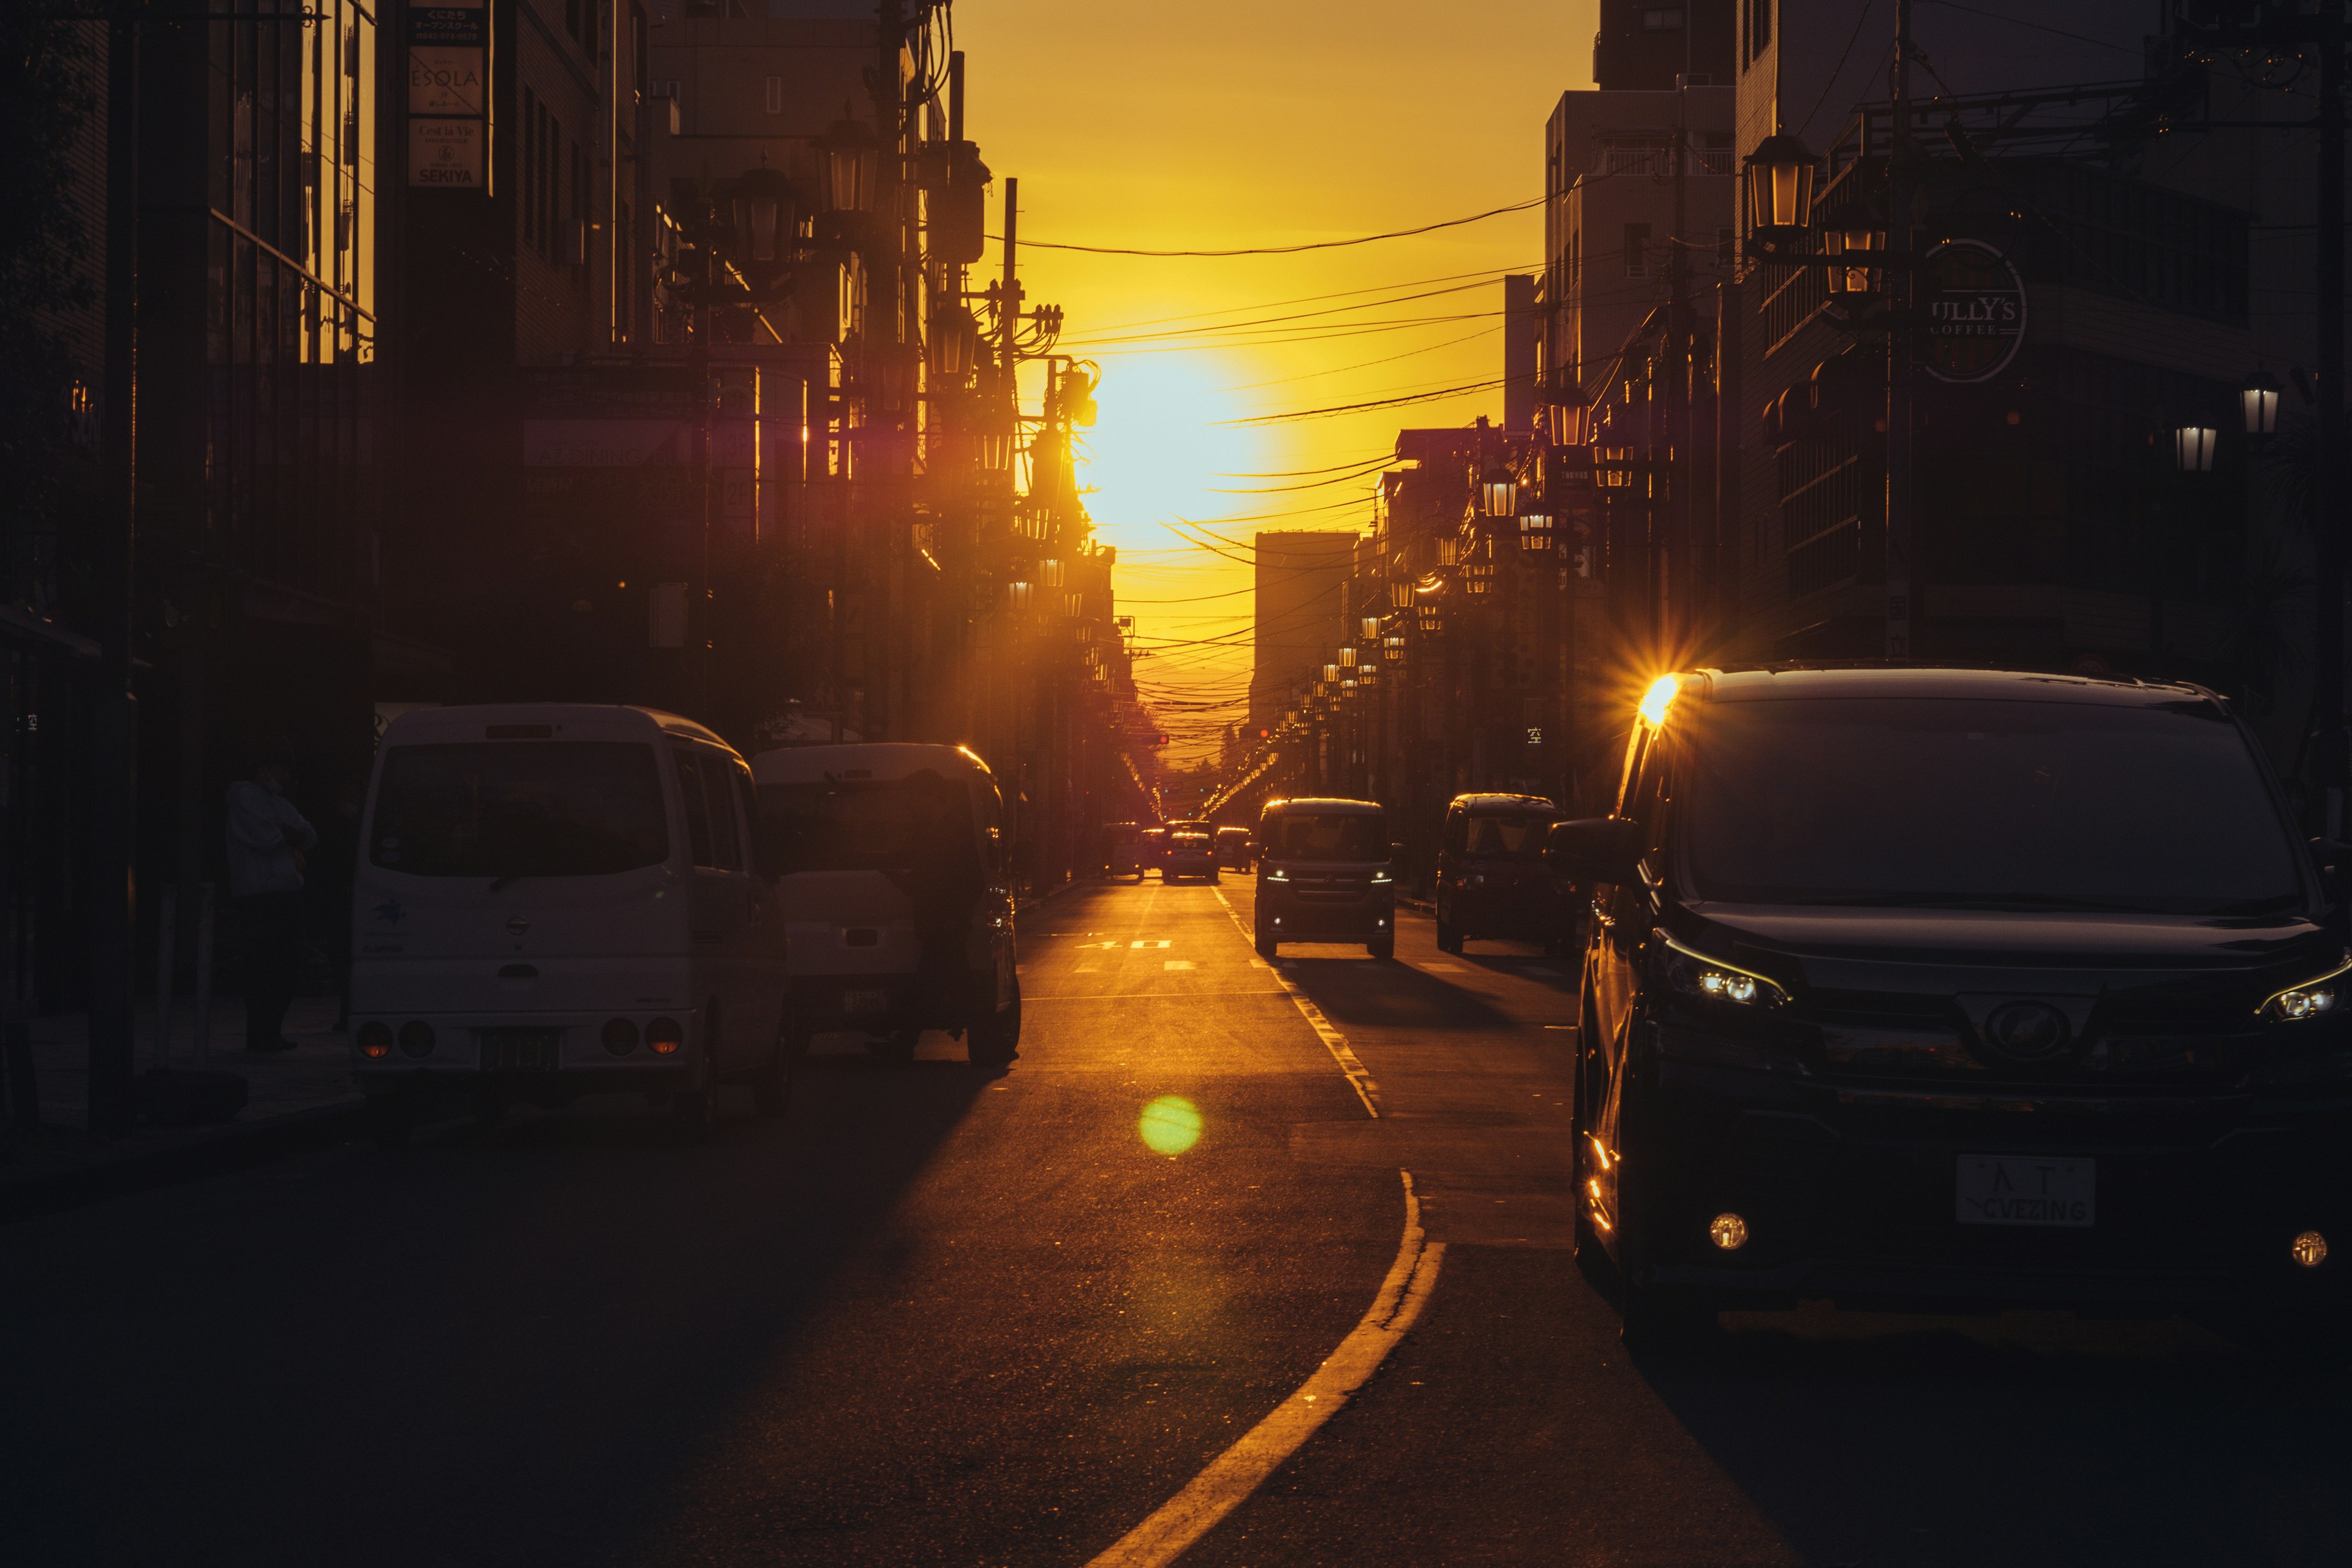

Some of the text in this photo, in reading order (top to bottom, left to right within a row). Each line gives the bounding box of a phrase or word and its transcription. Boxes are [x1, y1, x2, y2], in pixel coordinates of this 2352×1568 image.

[428, 10, 466, 20] くにたち
[415, 21, 479, 30] オープンスクール
[458, 126, 473, 136] Vie
[420, 169, 472, 183] SEKIYA
[1931, 297, 2015, 320] ULLY'S
[1528, 726, 1541, 744] 空
